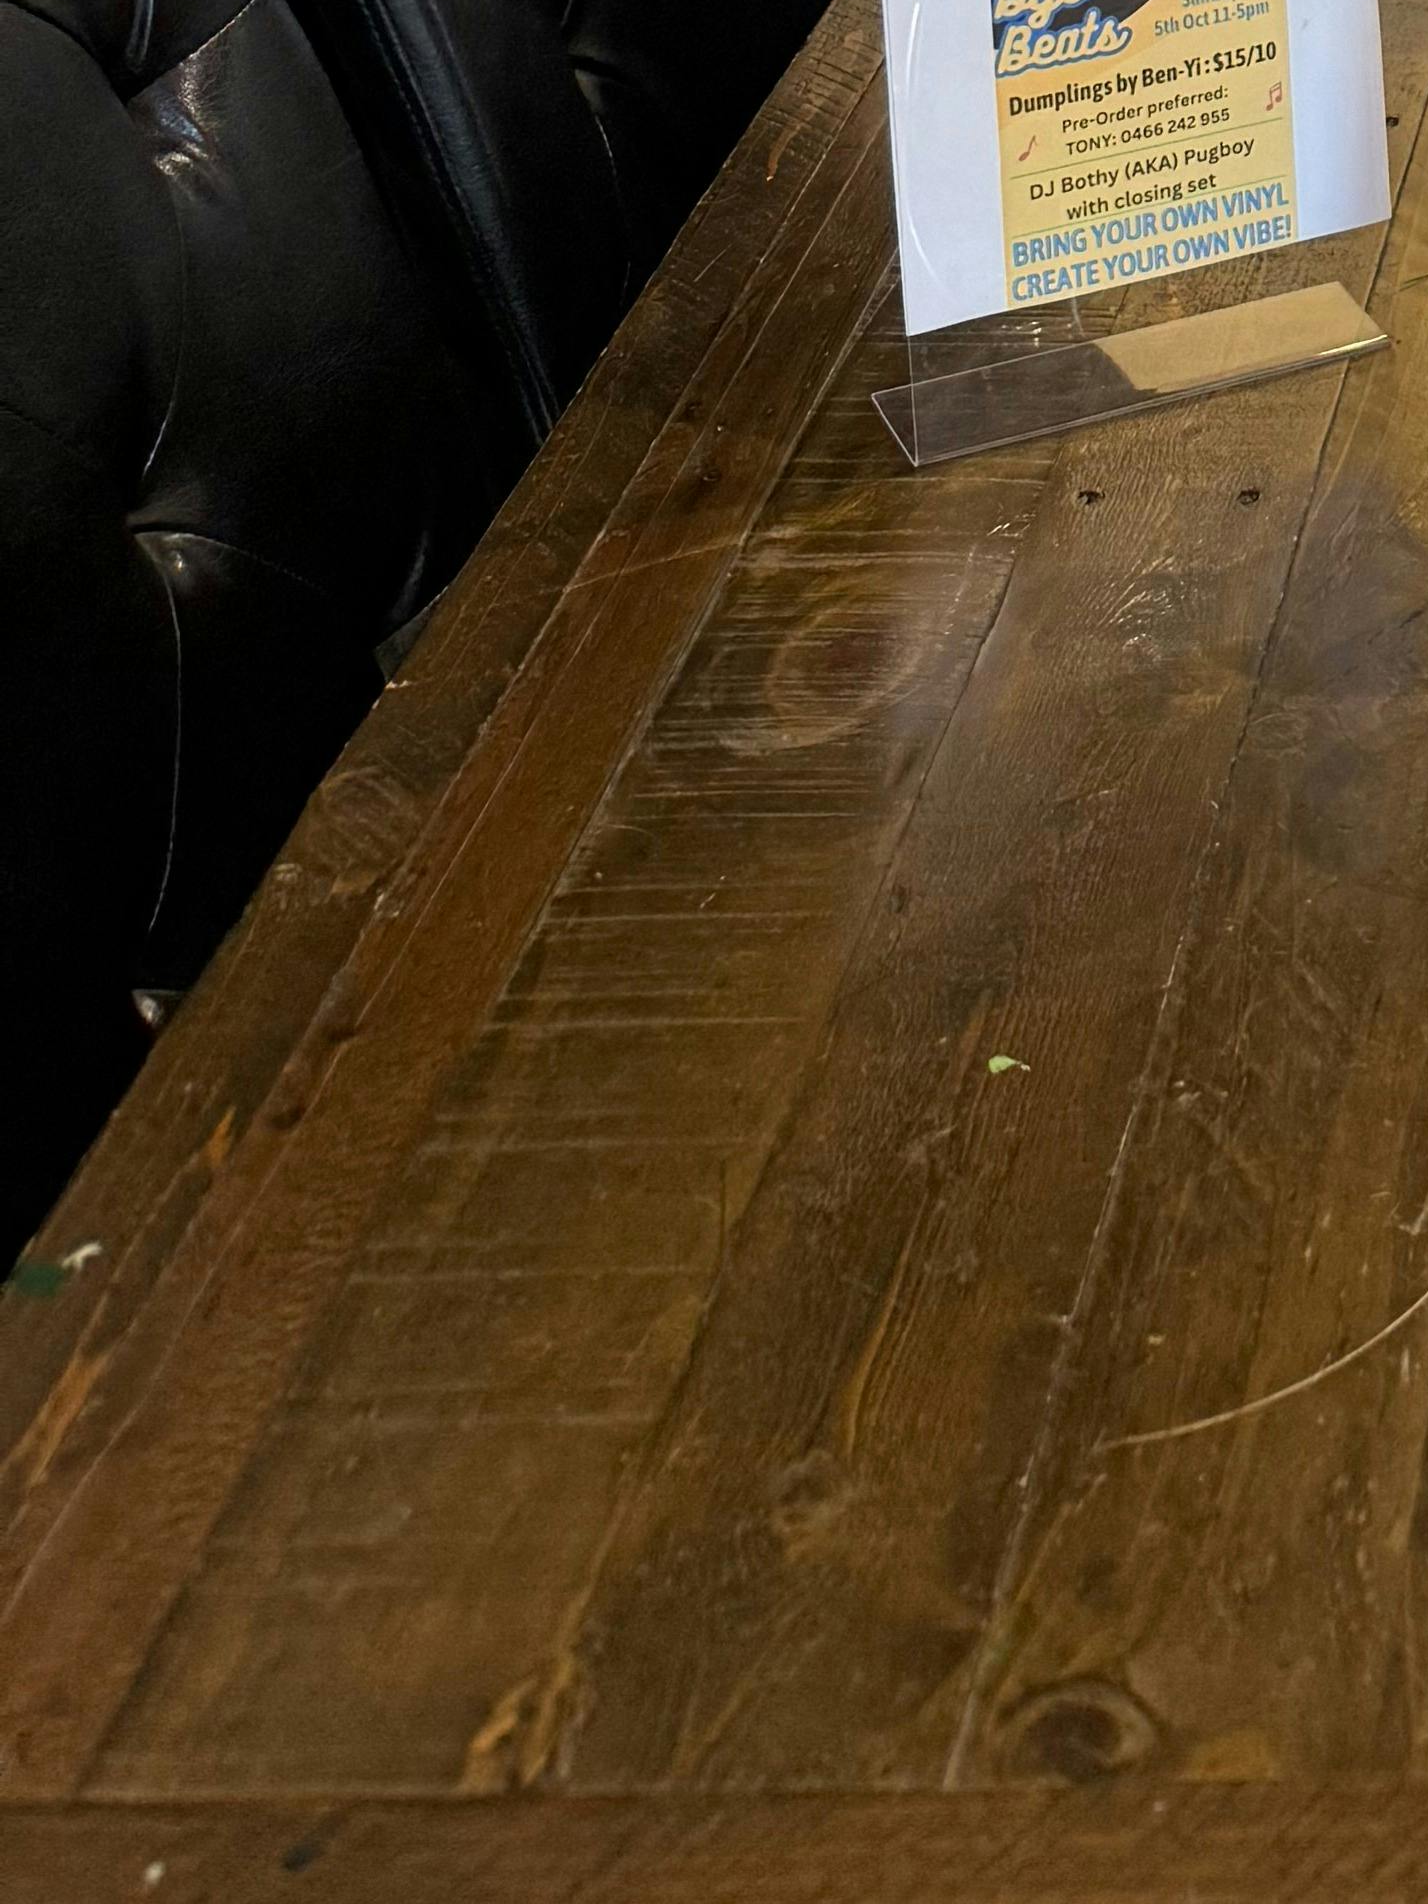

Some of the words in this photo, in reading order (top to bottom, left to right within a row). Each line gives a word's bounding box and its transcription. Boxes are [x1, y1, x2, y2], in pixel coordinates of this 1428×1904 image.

[996, 10, 1131, 75] Beats
[1154, 15, 1181, 37] 5th
[1182, 11, 1210, 31] Oct
[1212, 1, 1271, 25] 11-5pm
[1008, 78, 1113, 118] Dumplings
[1116, 71, 1138, 95] by
[1212, 41, 1278, 74] $15/10
[1061, 105, 1144, 134] Pre-Order
[1147, 84, 1229, 118] preferred:
[1066, 135, 1117, 157] TONY:
[1120, 122, 1164, 144] 0466
[1167, 115, 1197, 134] 242
[1200, 107, 1231, 127] 955
[1030, 180, 1055, 201] DJ
[1061, 168, 1120, 194] Bothy
[1124, 151, 1178, 181] (AKA)
[1184, 137, 1255, 166] Pugboy
[1066, 197, 1109, 221] with
[1114, 181, 1183, 210] closing
[1188, 172, 1217, 191] set
[1012, 226, 1087, 268] BRING
[1091, 211, 1156, 249] YOUR
[1161, 195, 1219, 232] OWN
[1221, 181, 1290, 218] VINYL
[1011, 258, 1100, 302] CREATE
[1102, 244, 1171, 281] YOUR
[1173, 230, 1231, 265] OWN
[1233, 213, 1292, 249] VIBE!
